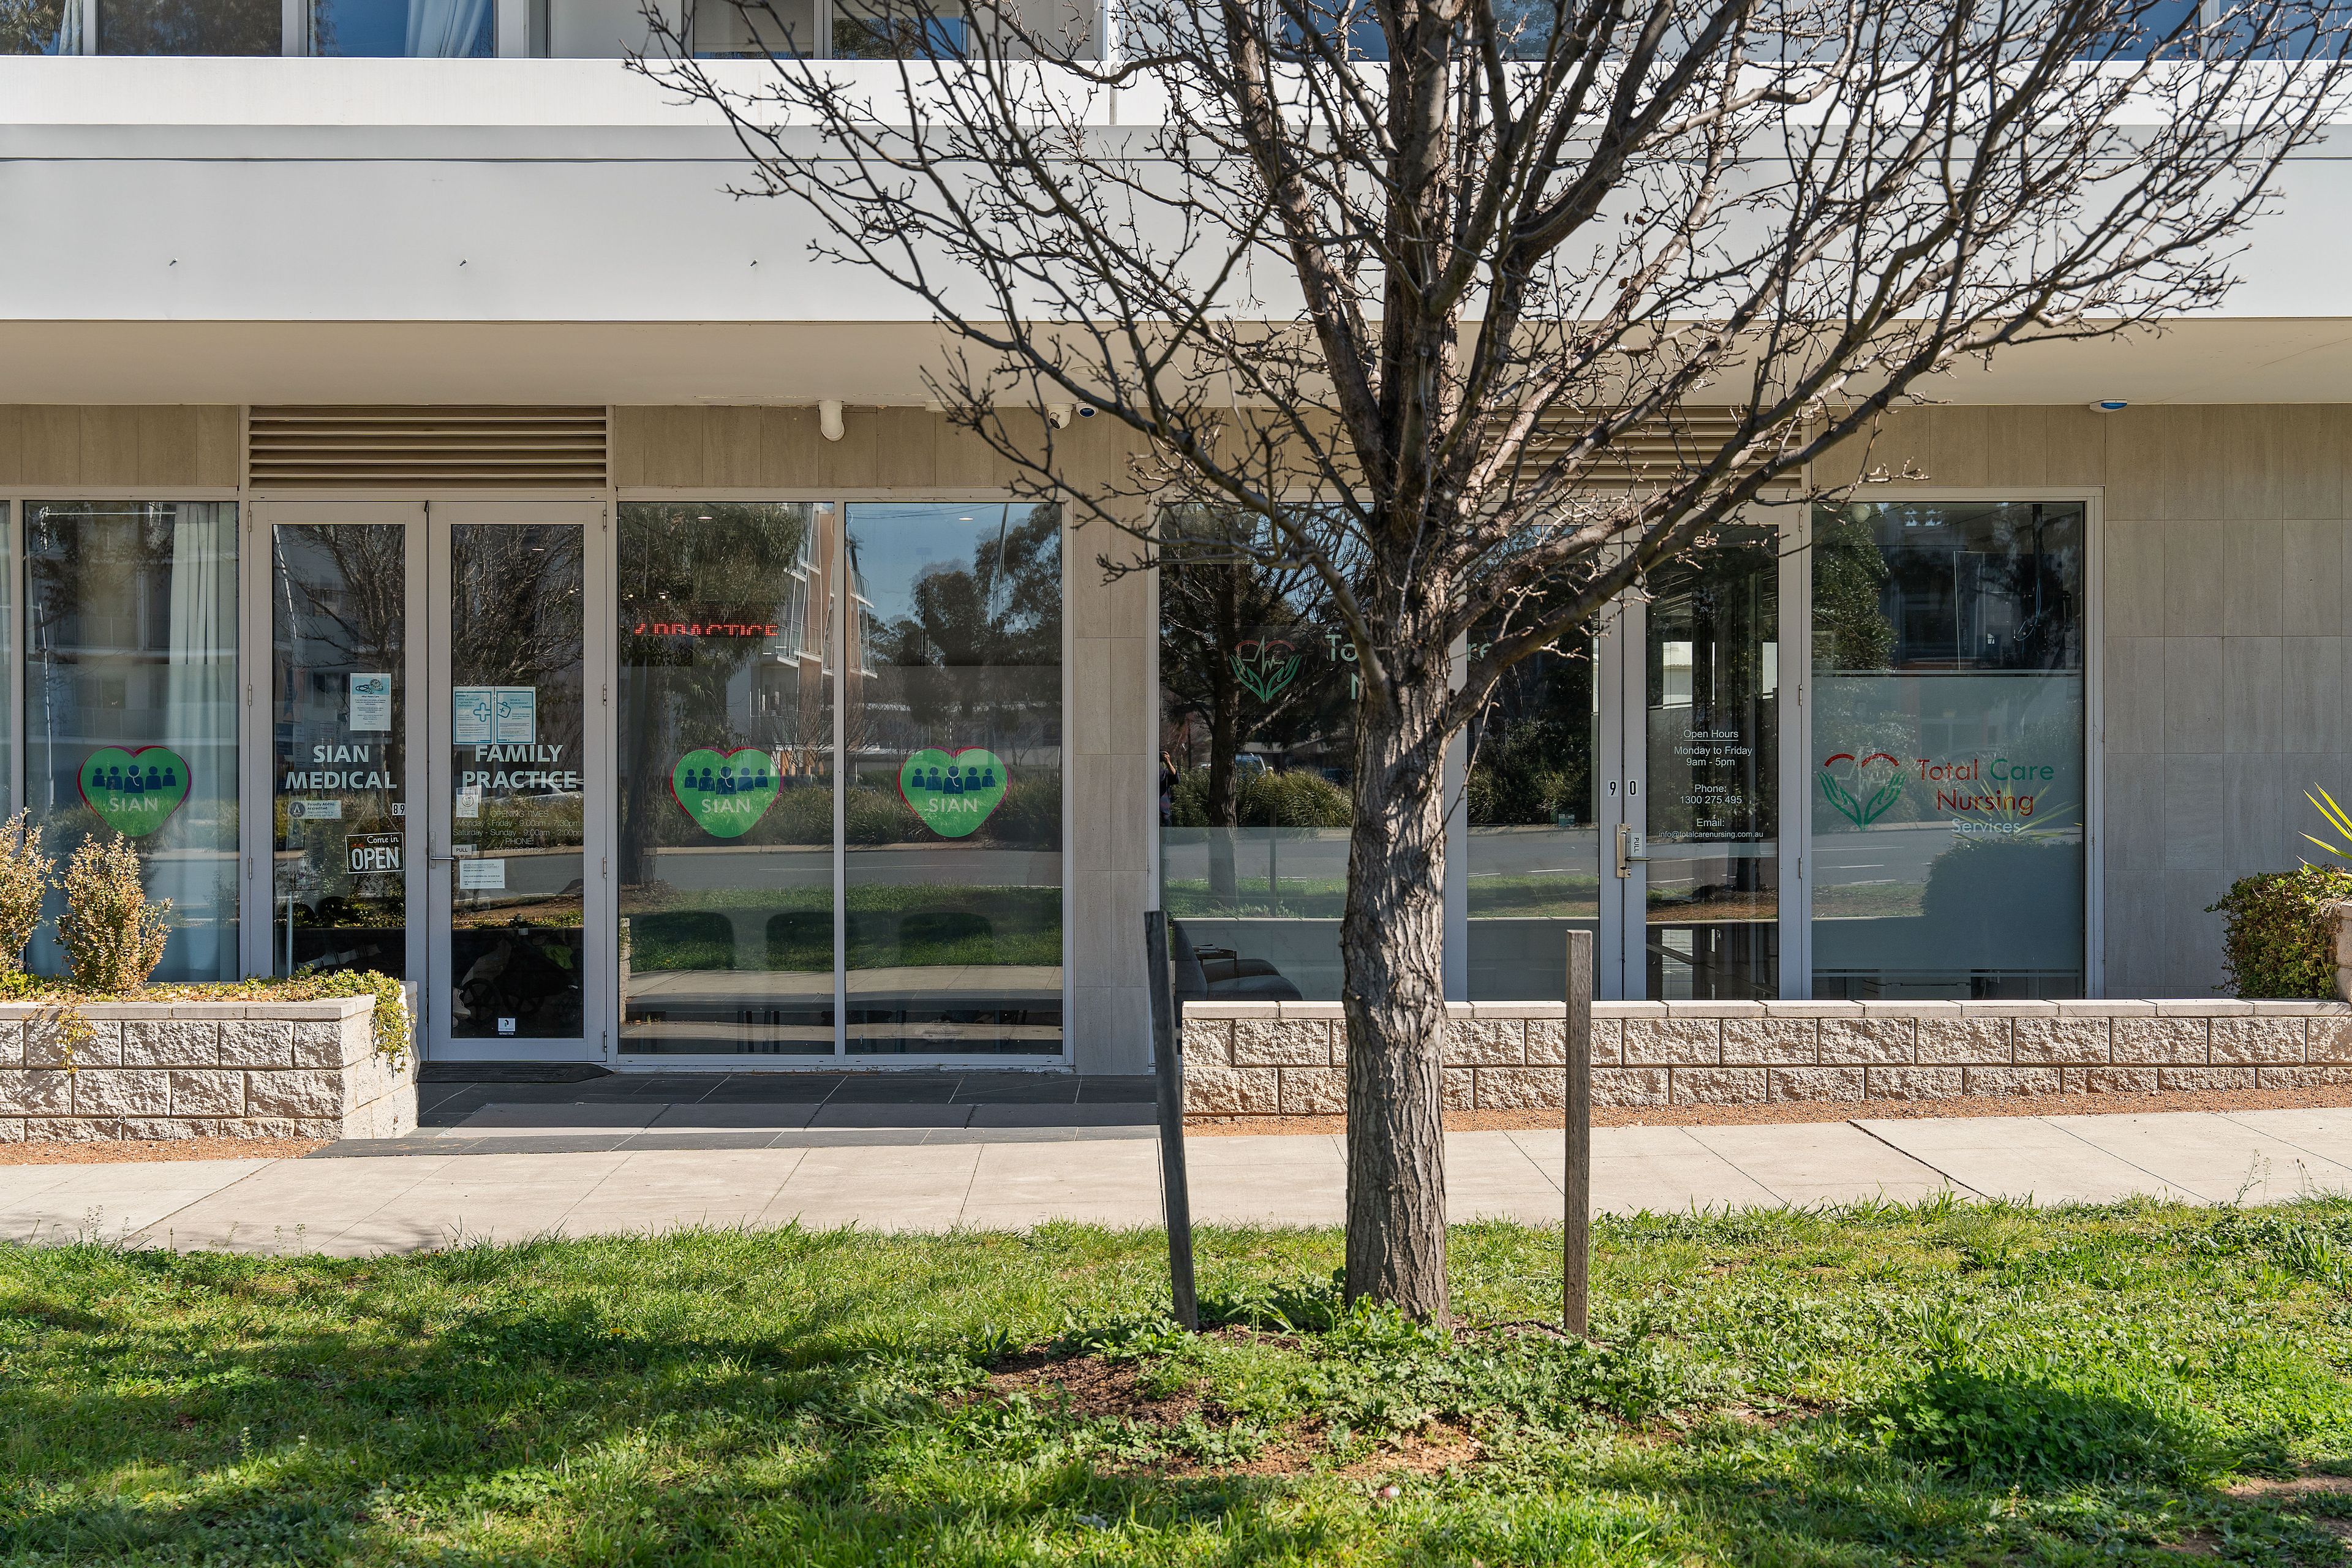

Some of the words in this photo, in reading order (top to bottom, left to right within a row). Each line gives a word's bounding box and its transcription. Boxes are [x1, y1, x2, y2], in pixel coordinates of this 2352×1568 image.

[1683, 729, 1708, 739] Open
[1711, 729, 1739, 738] Hours
[313, 745, 369, 763] SIAN
[475, 745, 564, 763] FAMILY
[1674, 746, 1711, 756] Monday
[1725, 746, 1752, 756] Friday
[1686, 758, 1706, 766] 9am
[1715, 758, 1735, 769] 5pm
[1917, 759, 1978, 781] Total
[1990, 758, 2055, 782] Care
[285, 771, 398, 789] MEDICAL
[462, 771, 577, 788] PRACTICE
[1694, 784, 1727, 793] Phone:
[109, 797, 158, 812] SIAN
[393, 804, 405, 815] 89
[701, 798, 750, 813] SIAN
[929, 797, 978, 813] SIAN
[1937, 789, 2034, 816] Nursing
[492, 820, 513, 828] Friday
[1697, 818, 1725, 827] Email:
[1951, 818, 2021, 834] Services
[390, 834, 399, 843] in
[453, 829, 483, 837] Saturday
[490, 829, 517, 837] Sunday
[1659, 830, 1763, 839] info@totalcarenursing.com.au
[352, 846, 399, 870] OPEN
